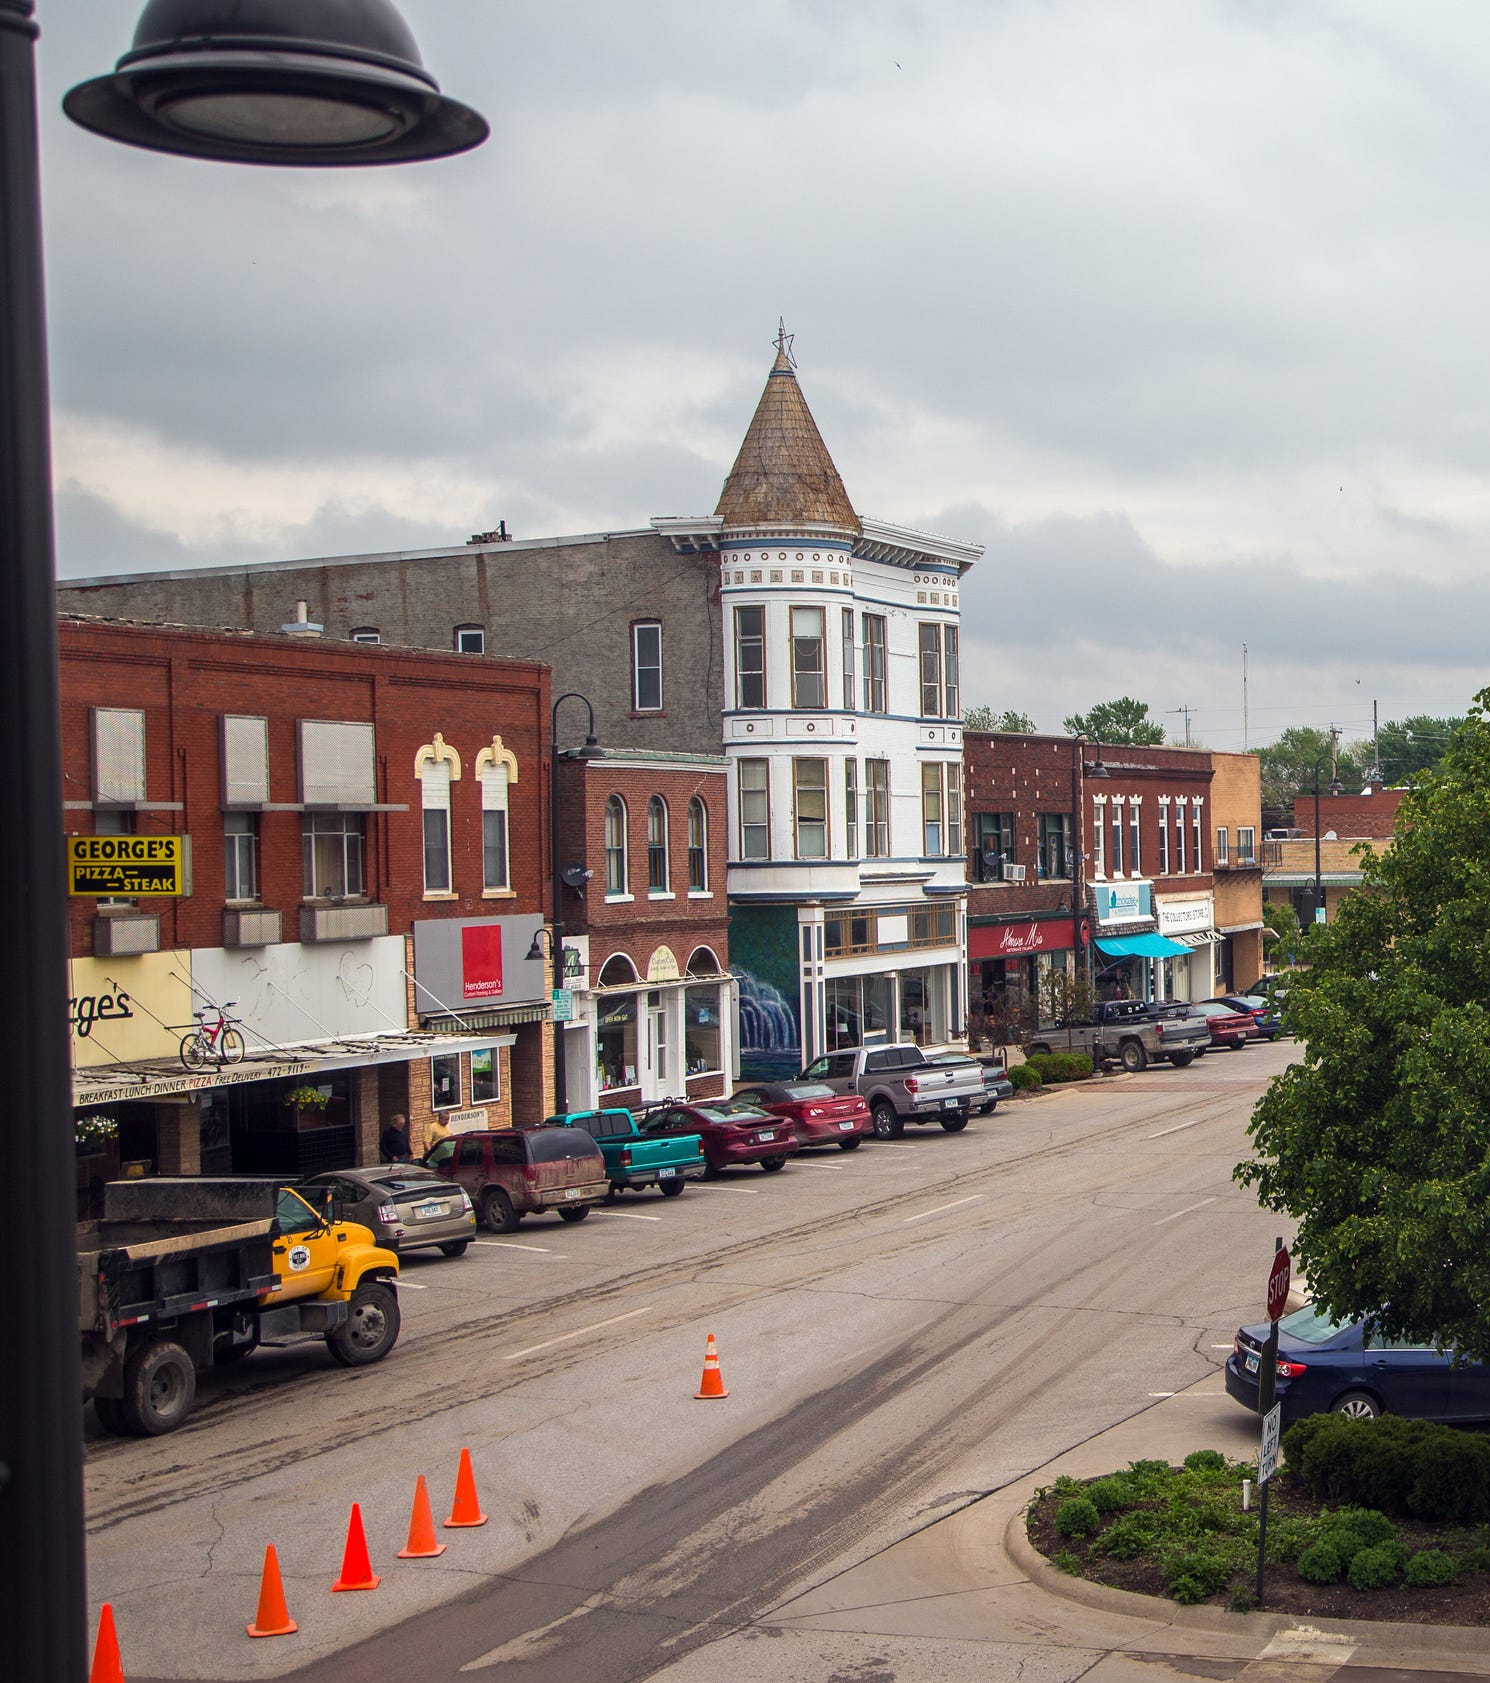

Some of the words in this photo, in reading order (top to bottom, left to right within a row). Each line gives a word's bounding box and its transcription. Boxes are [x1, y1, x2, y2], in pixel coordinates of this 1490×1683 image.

[74, 840, 175, 859] GEORGE'S
[464, 979, 502, 991] Henderson's
[124, 1082, 152, 1099] LUNCH
[154, 1079, 186, 1094] DINNER
[1268, 1266, 1290, 1305] STOP
[1266, 1414, 1277, 1437] NO
[1263, 1434, 1278, 1458] LEFT
[1261, 1453, 1277, 1477] TURN
